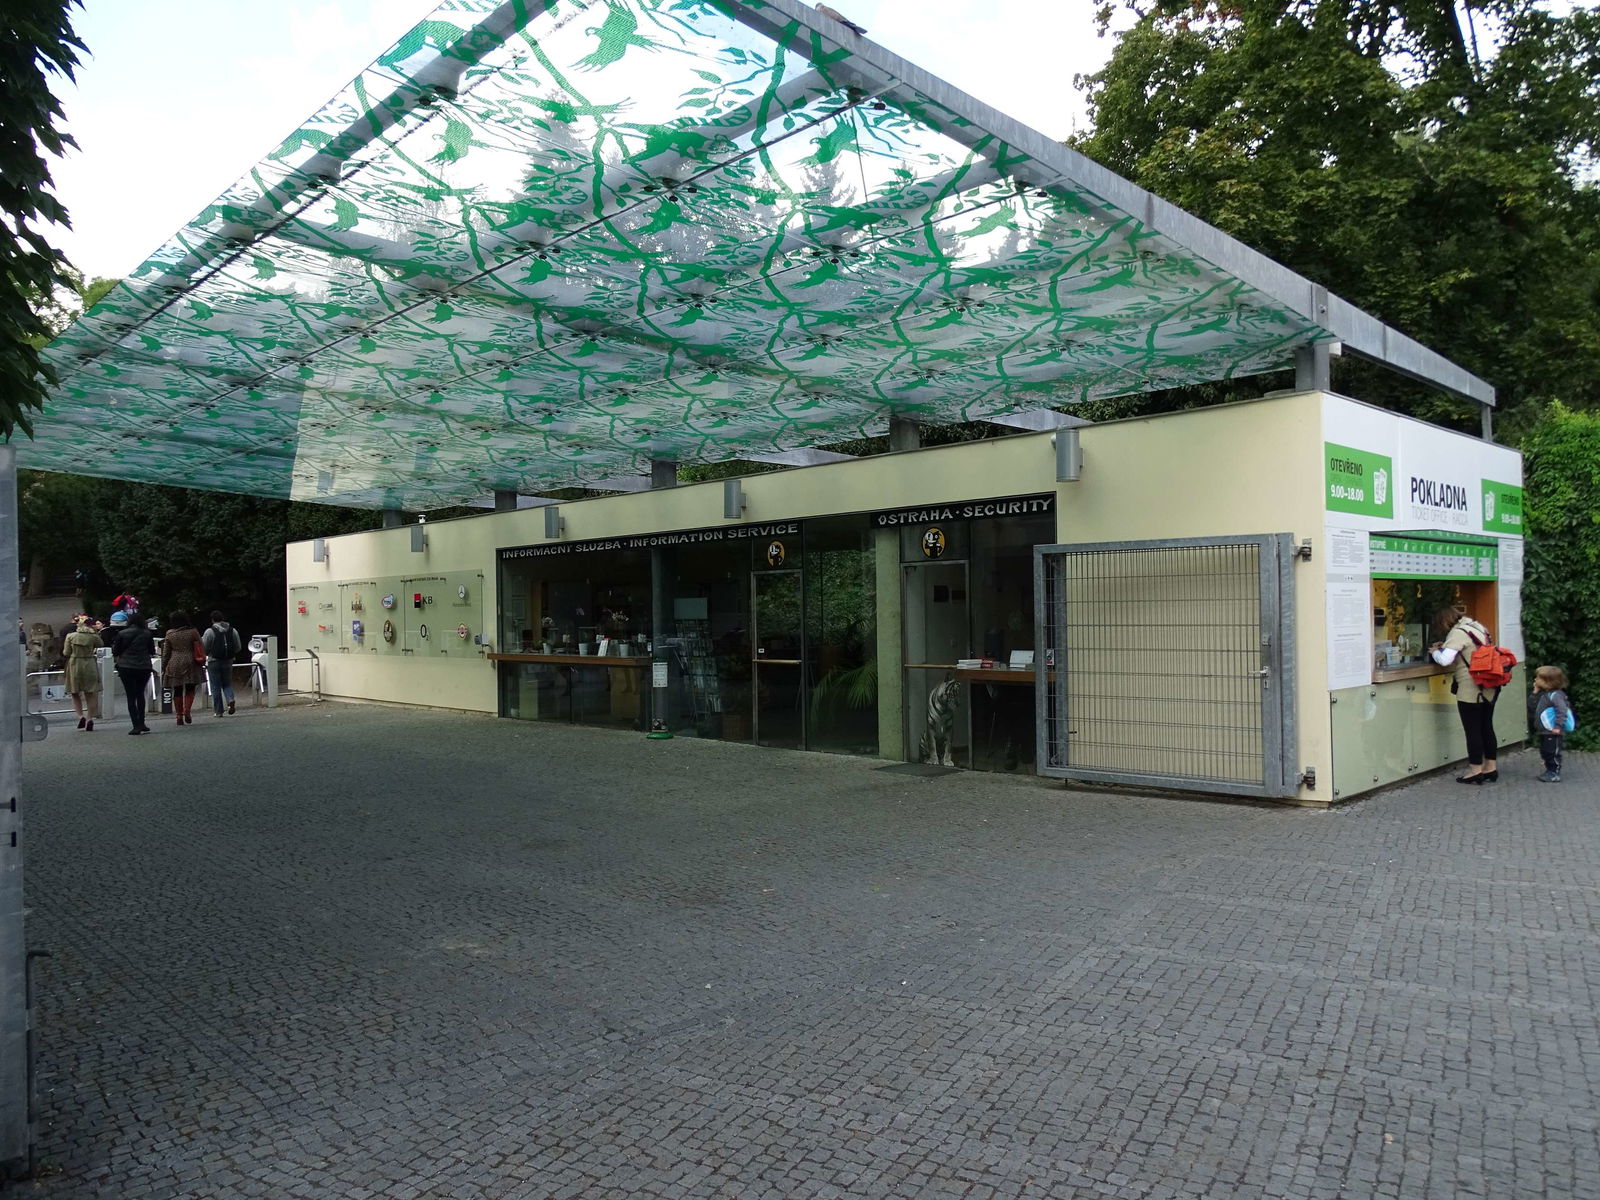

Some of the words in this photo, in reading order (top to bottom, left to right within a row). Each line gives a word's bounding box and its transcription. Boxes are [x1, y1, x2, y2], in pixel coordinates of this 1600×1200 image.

[1330, 457, 1363, 477] OTEVŘENO
[1410, 476, 1468, 511] POKLADNA
[878, 507, 953, 526] OSTRAHA
[962, 498, 1052, 518] SECURITY
[629, 530, 723, 548] INFORMATION
[727, 523, 798, 539] SERVICE
[422, 596, 433, 605] KB
